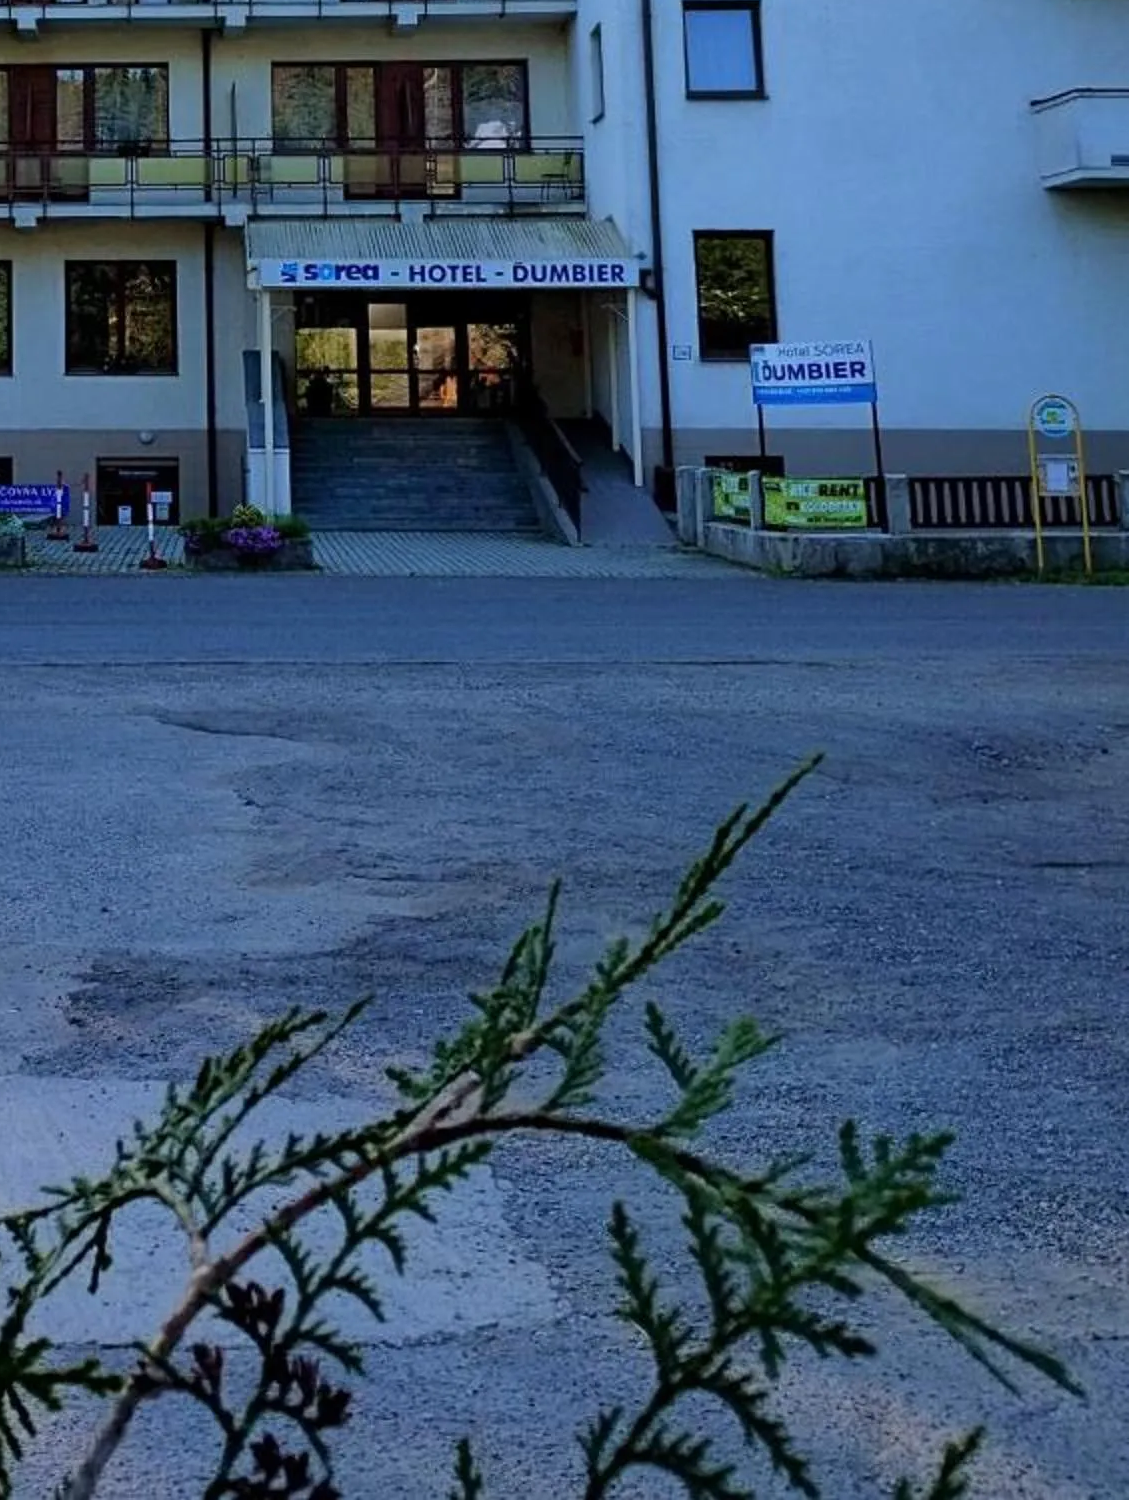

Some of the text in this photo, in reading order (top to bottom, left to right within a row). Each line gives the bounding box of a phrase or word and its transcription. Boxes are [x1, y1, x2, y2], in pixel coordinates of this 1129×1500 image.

[303, 263, 380, 282] sorea
[408, 264, 487, 283] HOTEL
[512, 261, 625, 283] ĎUMBIER
[778, 345, 810, 357] Hotel
[813, 342, 865, 356] SOREA
[761, 360, 866, 381] ĎUMBIER
[819, 483, 860, 497] RENT
